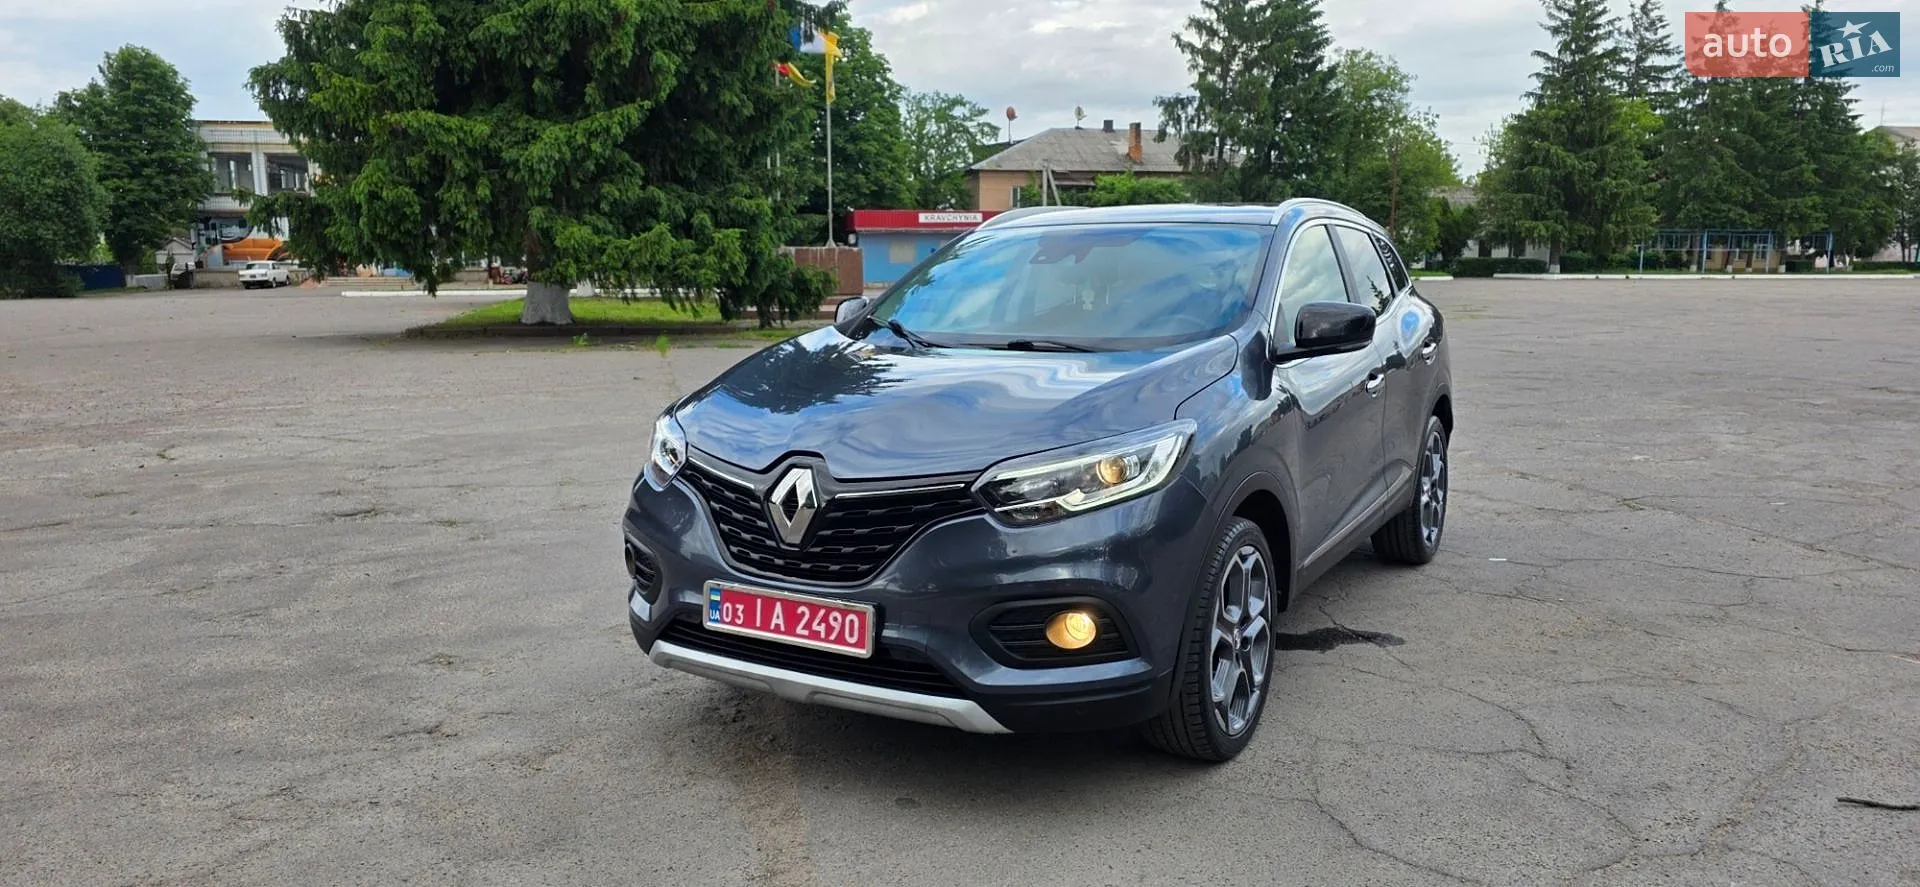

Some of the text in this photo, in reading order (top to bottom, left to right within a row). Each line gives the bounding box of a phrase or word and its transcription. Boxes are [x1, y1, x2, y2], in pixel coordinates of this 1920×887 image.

[709, 609, 721, 621] UA
[723, 602, 745, 625] 03
[796, 605, 860, 644] 2490
